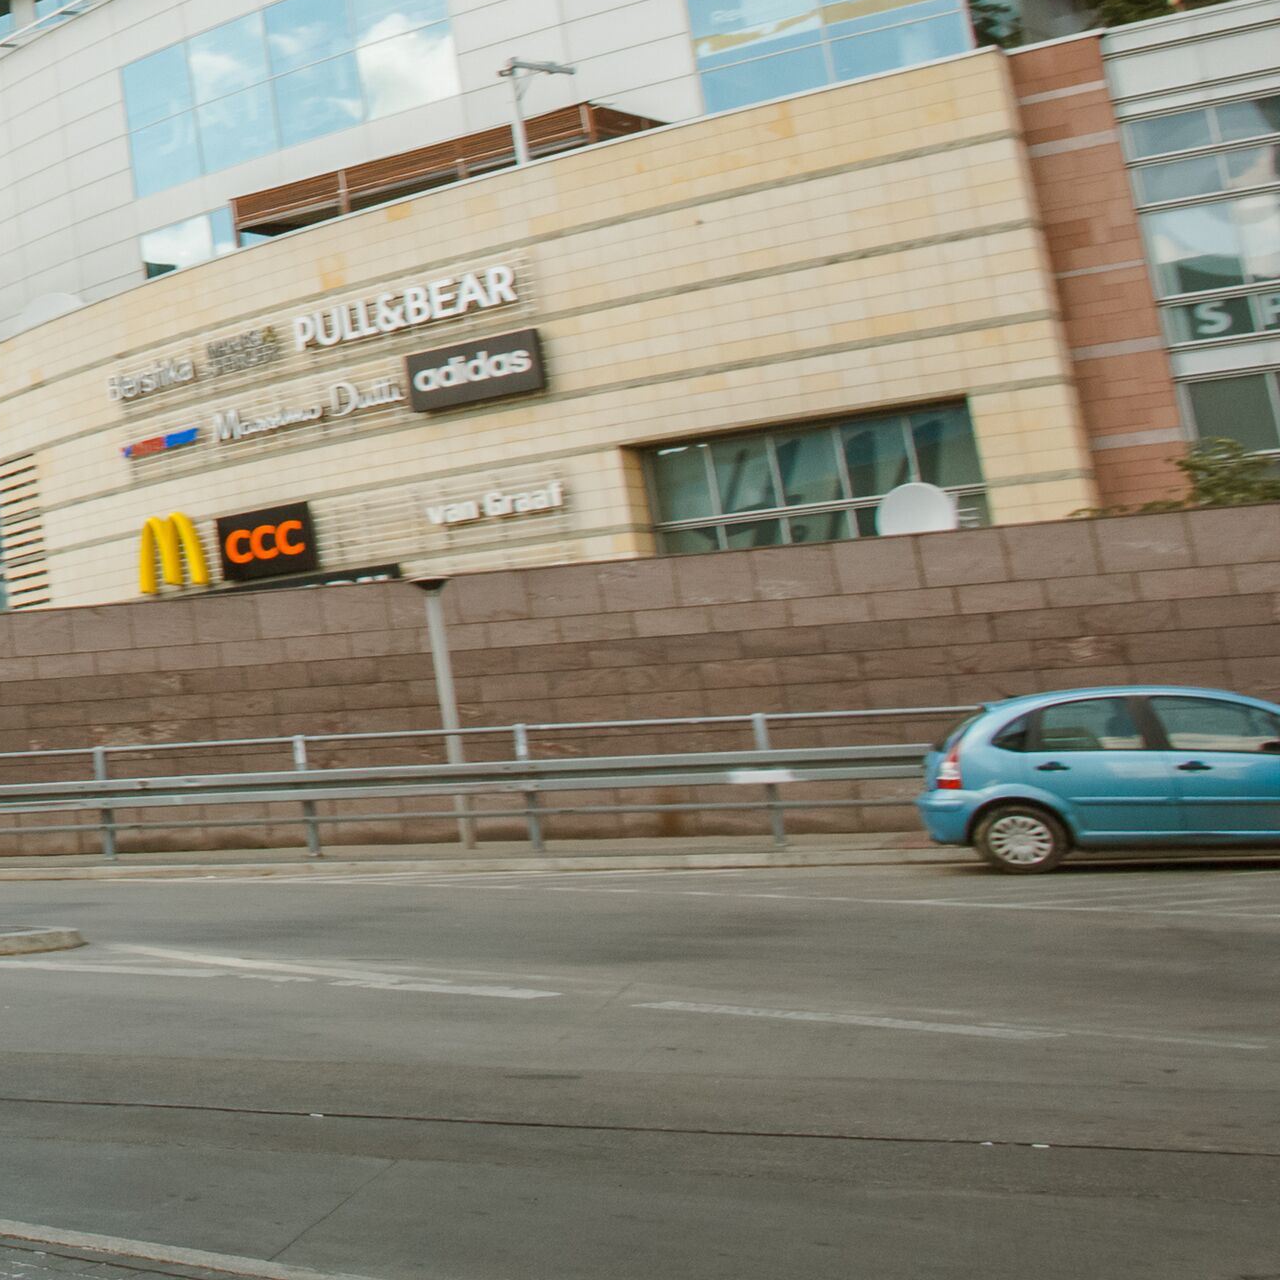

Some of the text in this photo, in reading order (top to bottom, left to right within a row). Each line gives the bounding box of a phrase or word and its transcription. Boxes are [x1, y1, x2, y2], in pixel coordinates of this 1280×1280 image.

[293, 265, 518, 352] PULL&BEAR
[413, 349, 533, 392] adidas
[426, 480, 564, 525] van Graaf
[225, 520, 306, 564] CCC
